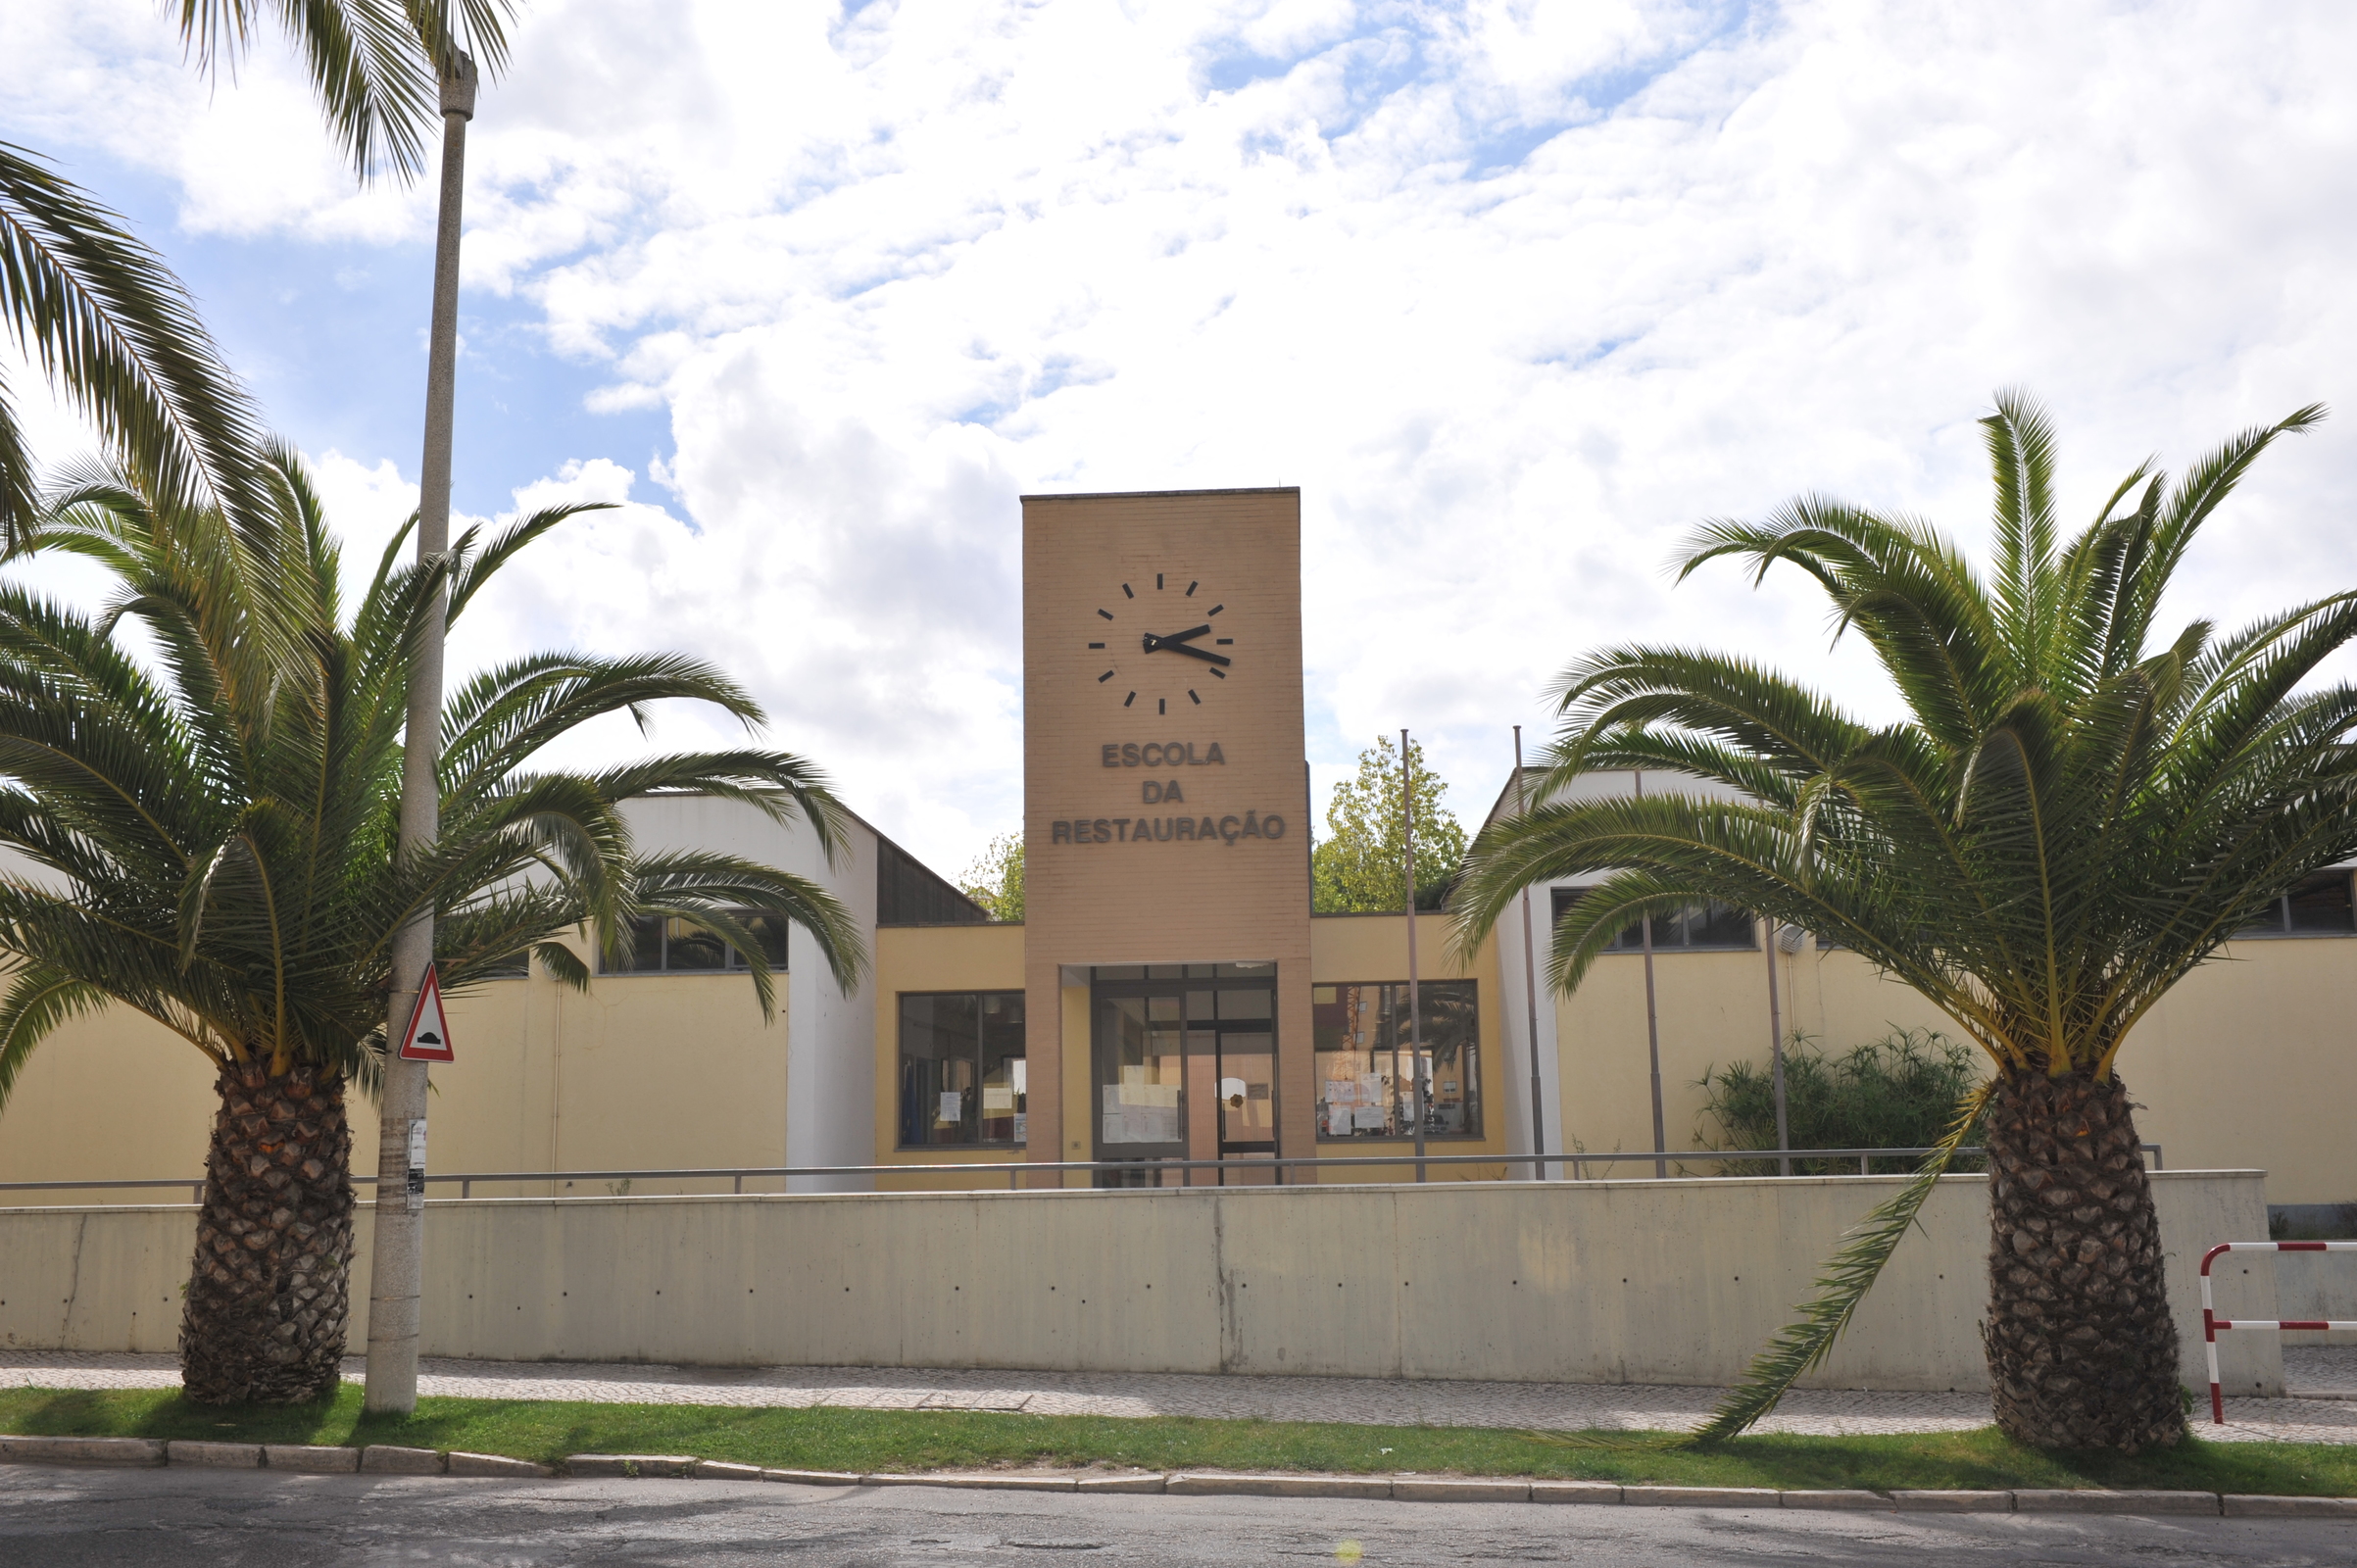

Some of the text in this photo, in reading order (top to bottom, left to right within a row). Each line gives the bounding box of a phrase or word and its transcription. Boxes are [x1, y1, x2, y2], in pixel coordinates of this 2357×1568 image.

[1102, 742, 1225, 767] ESCOLA
[1142, 780, 1184, 804] DA
[1052, 809, 1285, 846] RESTAURAÇÃO
